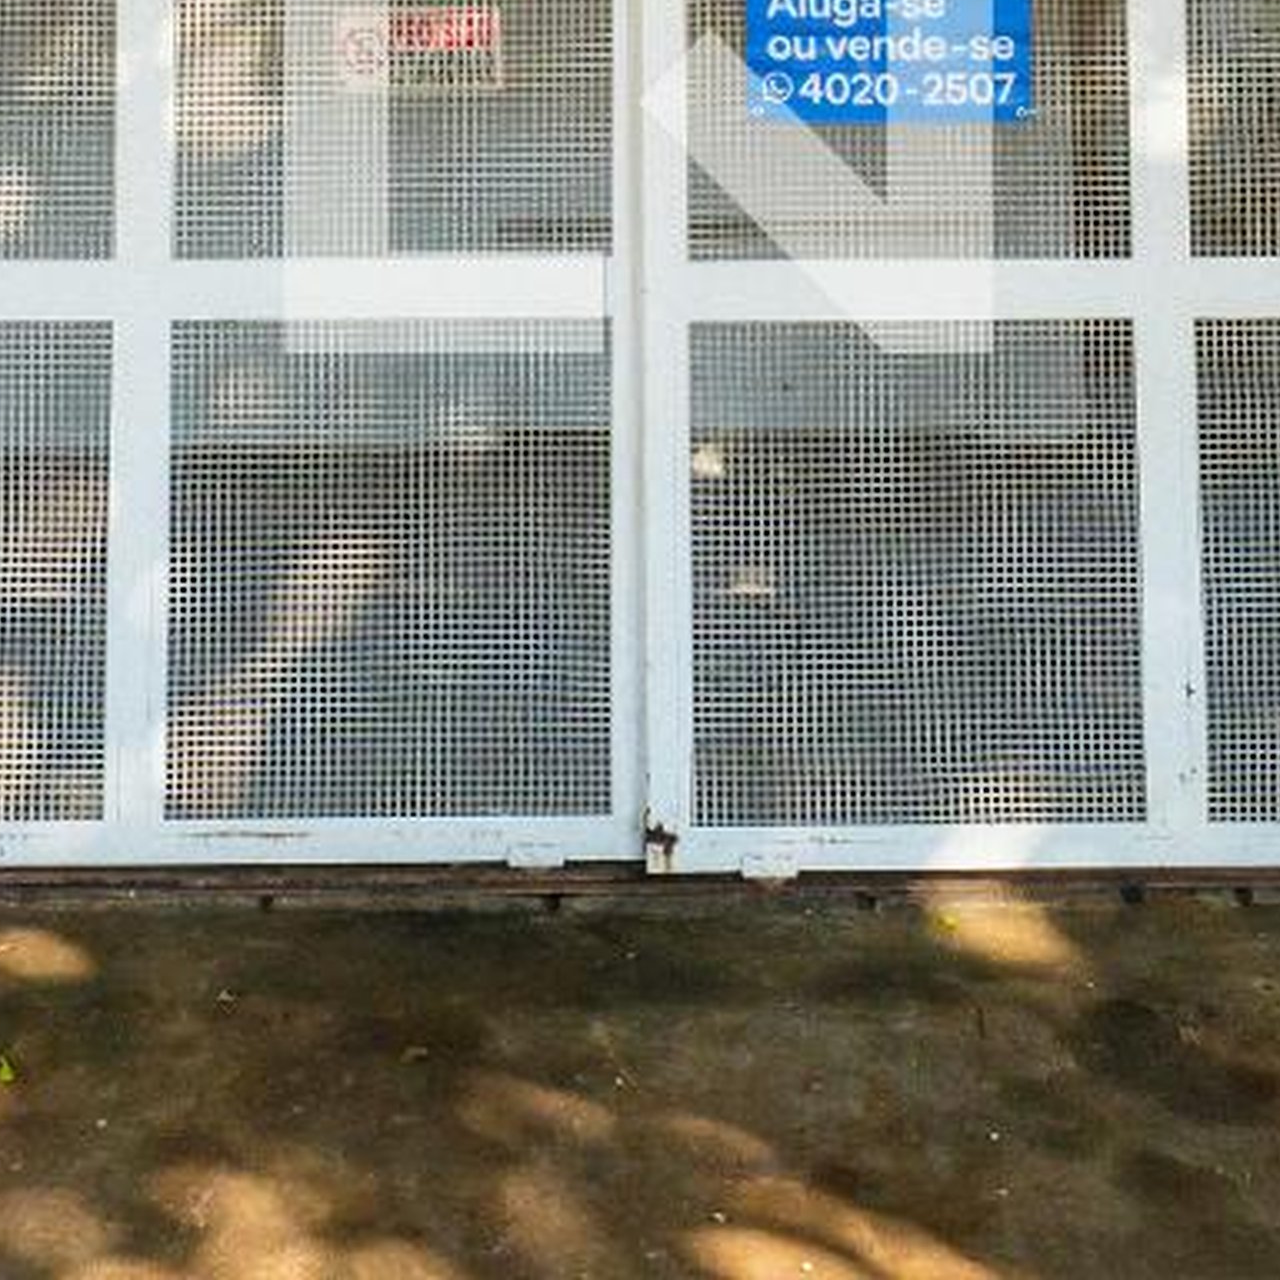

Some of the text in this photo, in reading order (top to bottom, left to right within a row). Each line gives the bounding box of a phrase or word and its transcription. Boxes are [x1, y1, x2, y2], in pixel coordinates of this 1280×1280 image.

[767, 28, 1016, 62] ou vende-se
[799, 73, 1016, 106] 4020-2507
